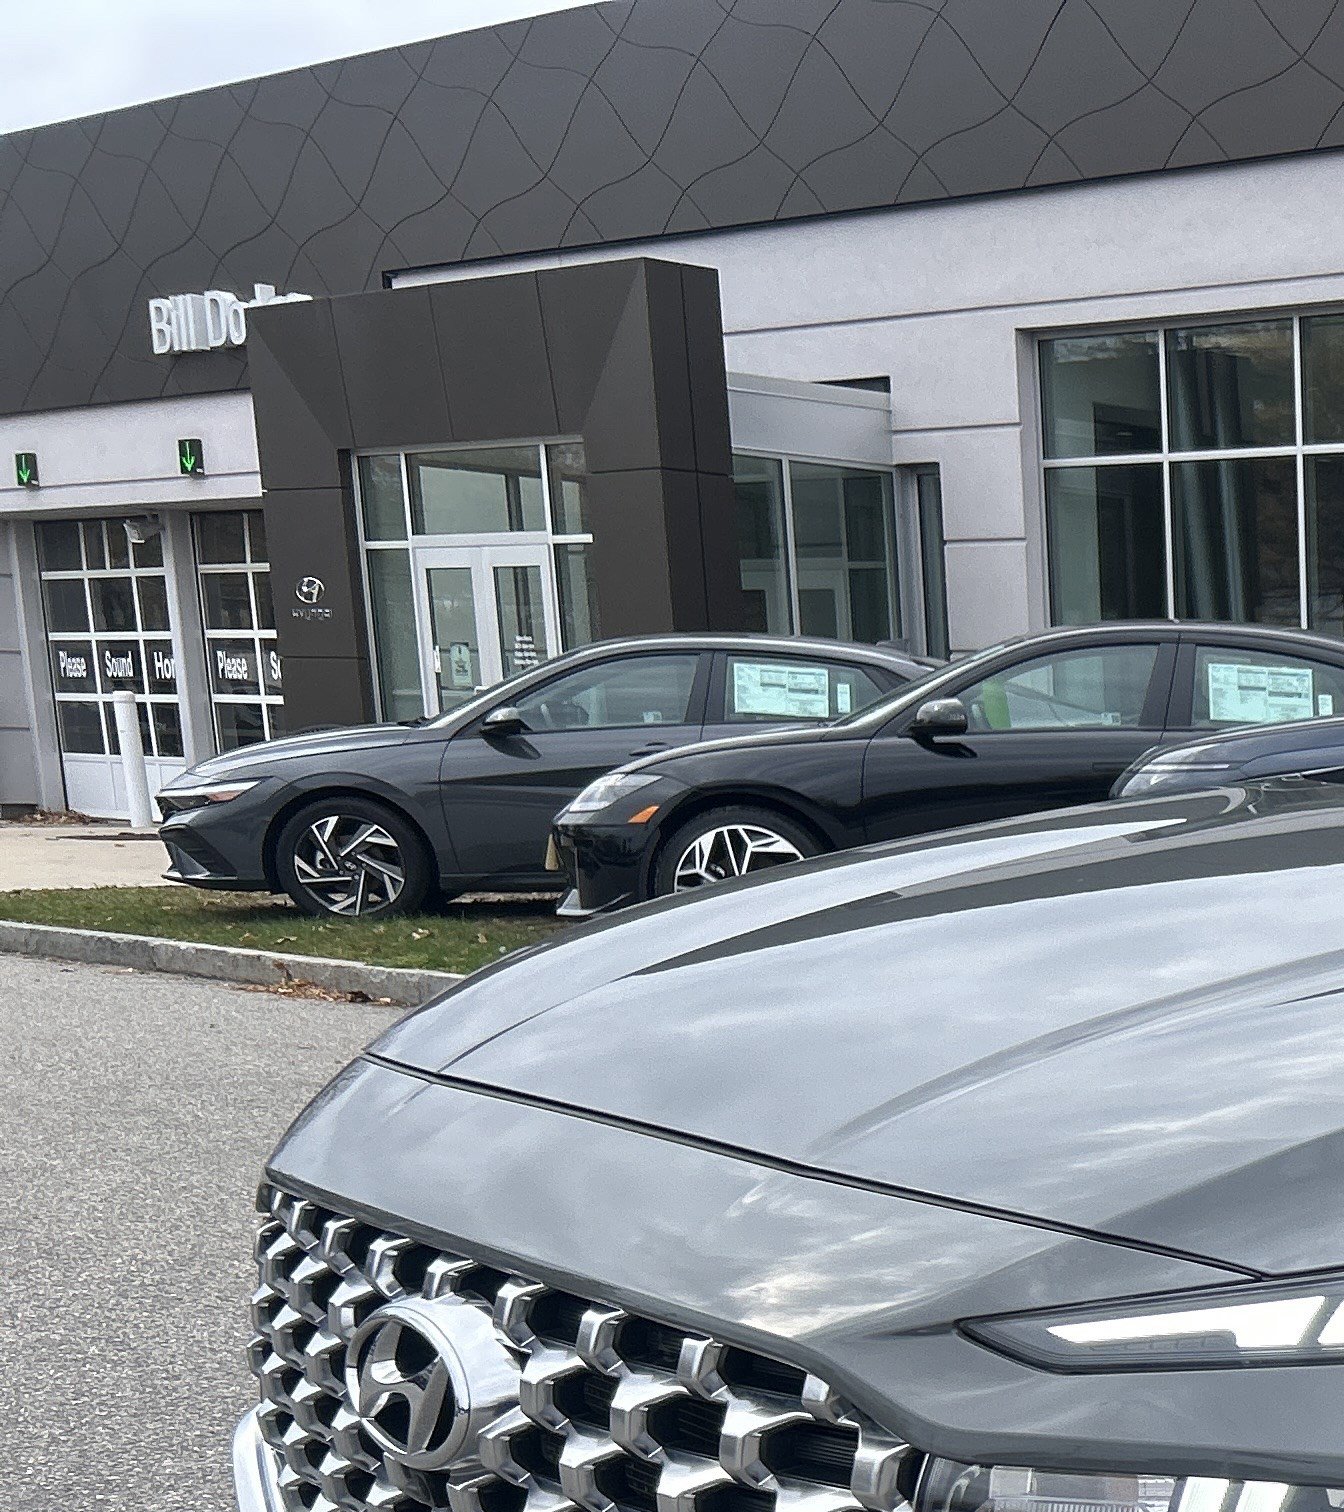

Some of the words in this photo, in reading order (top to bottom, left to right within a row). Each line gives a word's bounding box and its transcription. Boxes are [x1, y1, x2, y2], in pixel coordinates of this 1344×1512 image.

[149, 294, 207, 354] Bill
[58, 651, 88, 678] Please
[105, 651, 134, 678] Sound
[216, 650, 248, 680] Please
